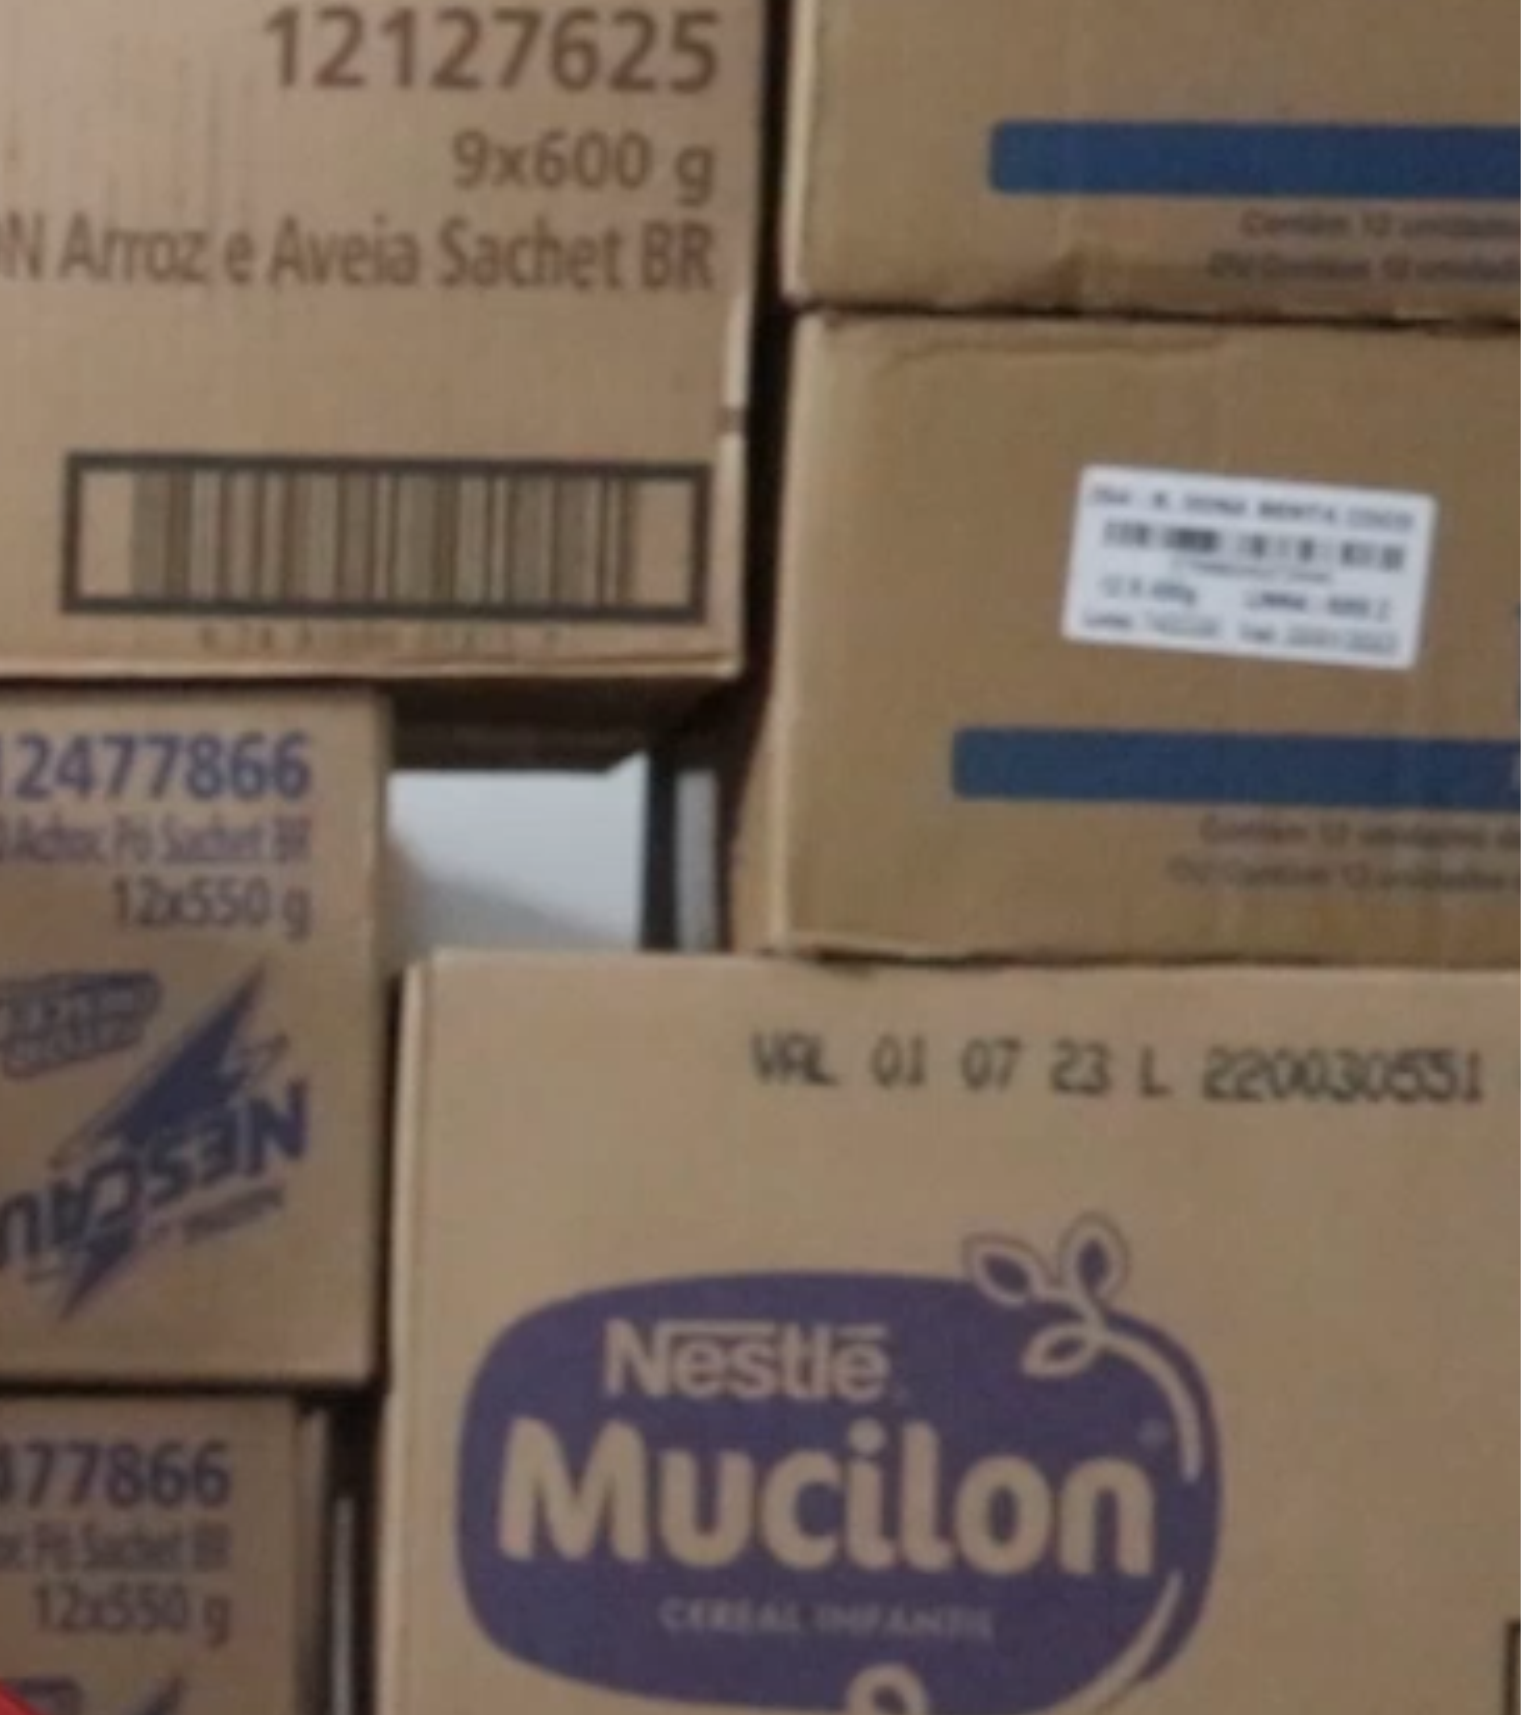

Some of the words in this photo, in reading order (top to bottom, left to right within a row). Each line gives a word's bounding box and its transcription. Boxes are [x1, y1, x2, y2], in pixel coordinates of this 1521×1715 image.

[263, 8, 718, 94] 12127625
[452, 131, 651, 190] 9x600
[675, 141, 714, 205] g
[58, 212, 208, 286] Arroz
[224, 230, 253, 286] e
[271, 216, 421, 290] Aveia
[442, 217, 622, 292] Sachet
[642, 221, 714, 293] BR
[111, 877, 270, 926] 12x550
[283, 886, 311, 941] g
[751, 1034, 836, 1086] VAL
[871, 1036, 925, 1087] 01
[961, 1038, 1022, 1091] 07
[1050, 1040, 1112, 1095] 23
[1140, 1045, 1170, 1097] L
[604, 1319, 891, 1401] Nestlé
[497, 1416, 1155, 1577] Mucilon
[202, 1593, 232, 1649] g
[659, 1600, 800, 1638] CEREAL
[817, 1602, 994, 1644] INFANTIL
